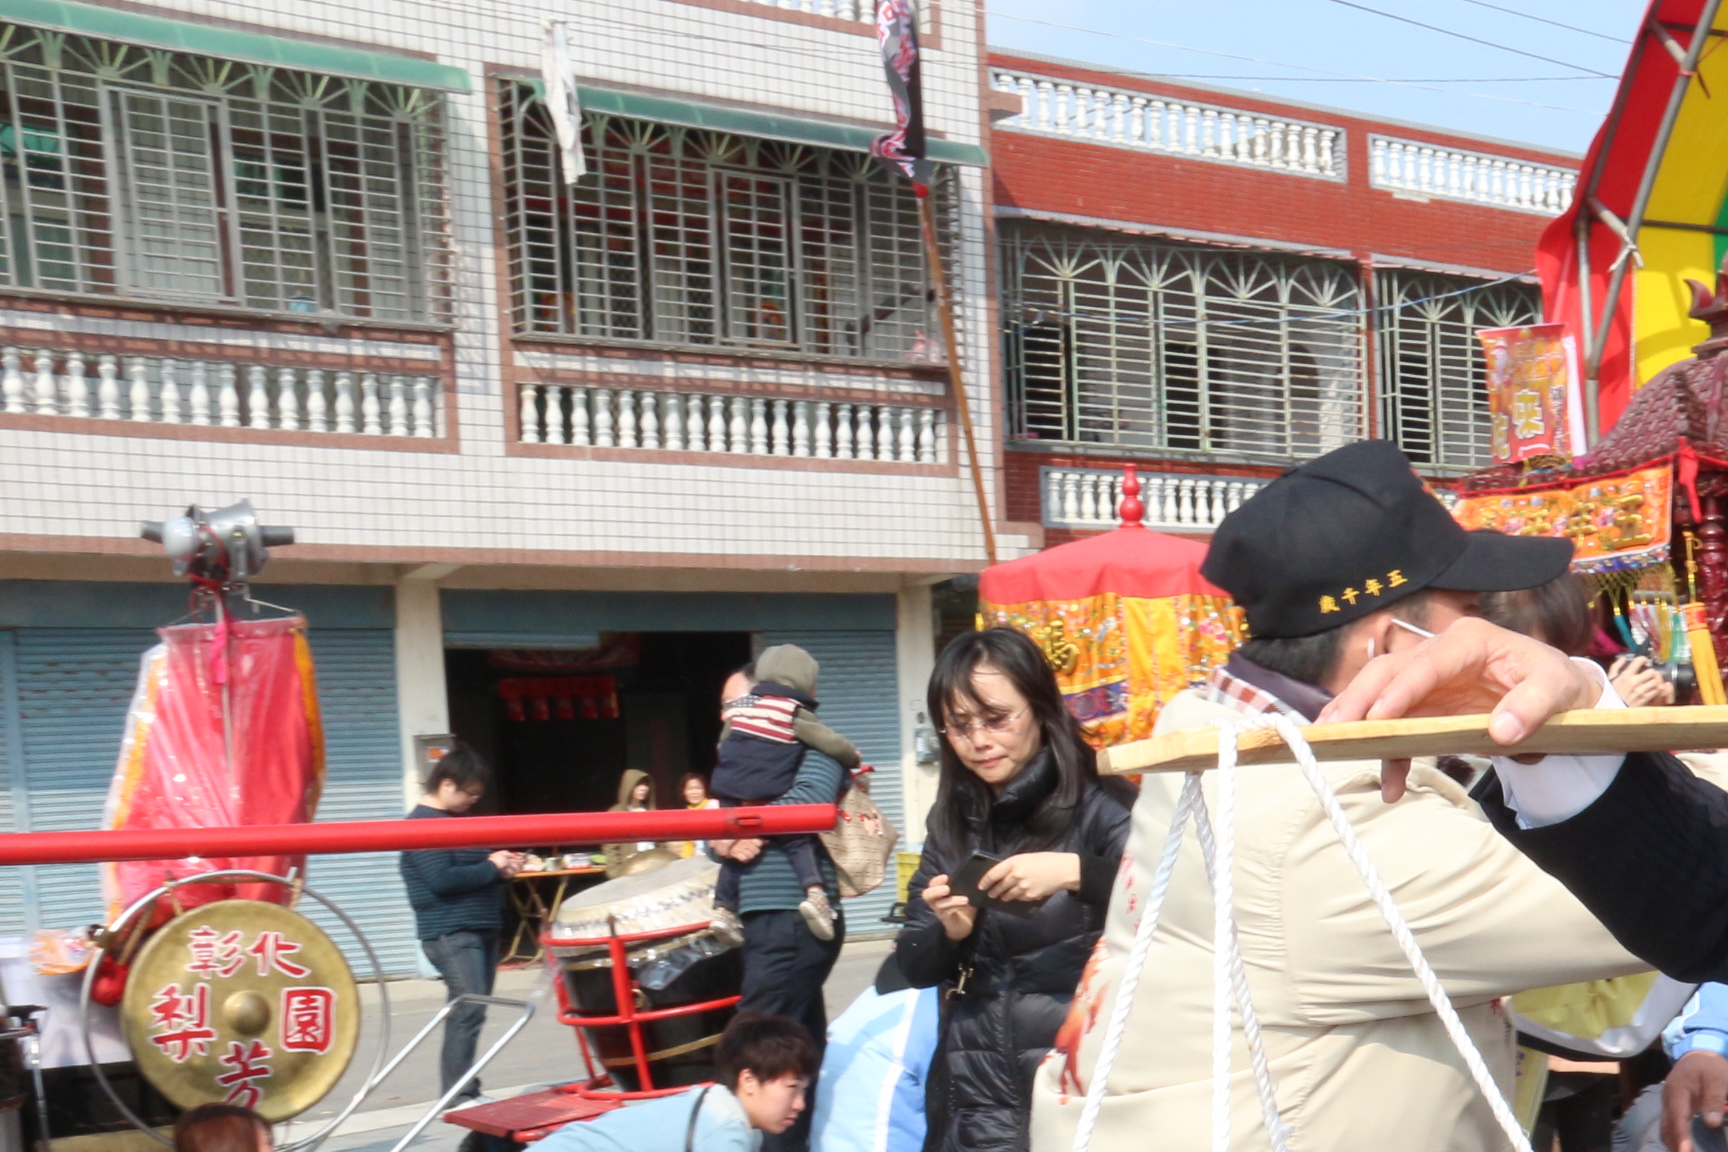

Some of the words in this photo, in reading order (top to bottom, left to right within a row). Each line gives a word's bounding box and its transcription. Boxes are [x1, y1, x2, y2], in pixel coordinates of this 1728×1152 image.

[184, 926, 311, 979] 彰化
[149, 982, 218, 1063] 梨
[279, 986, 337, 1054] 園
